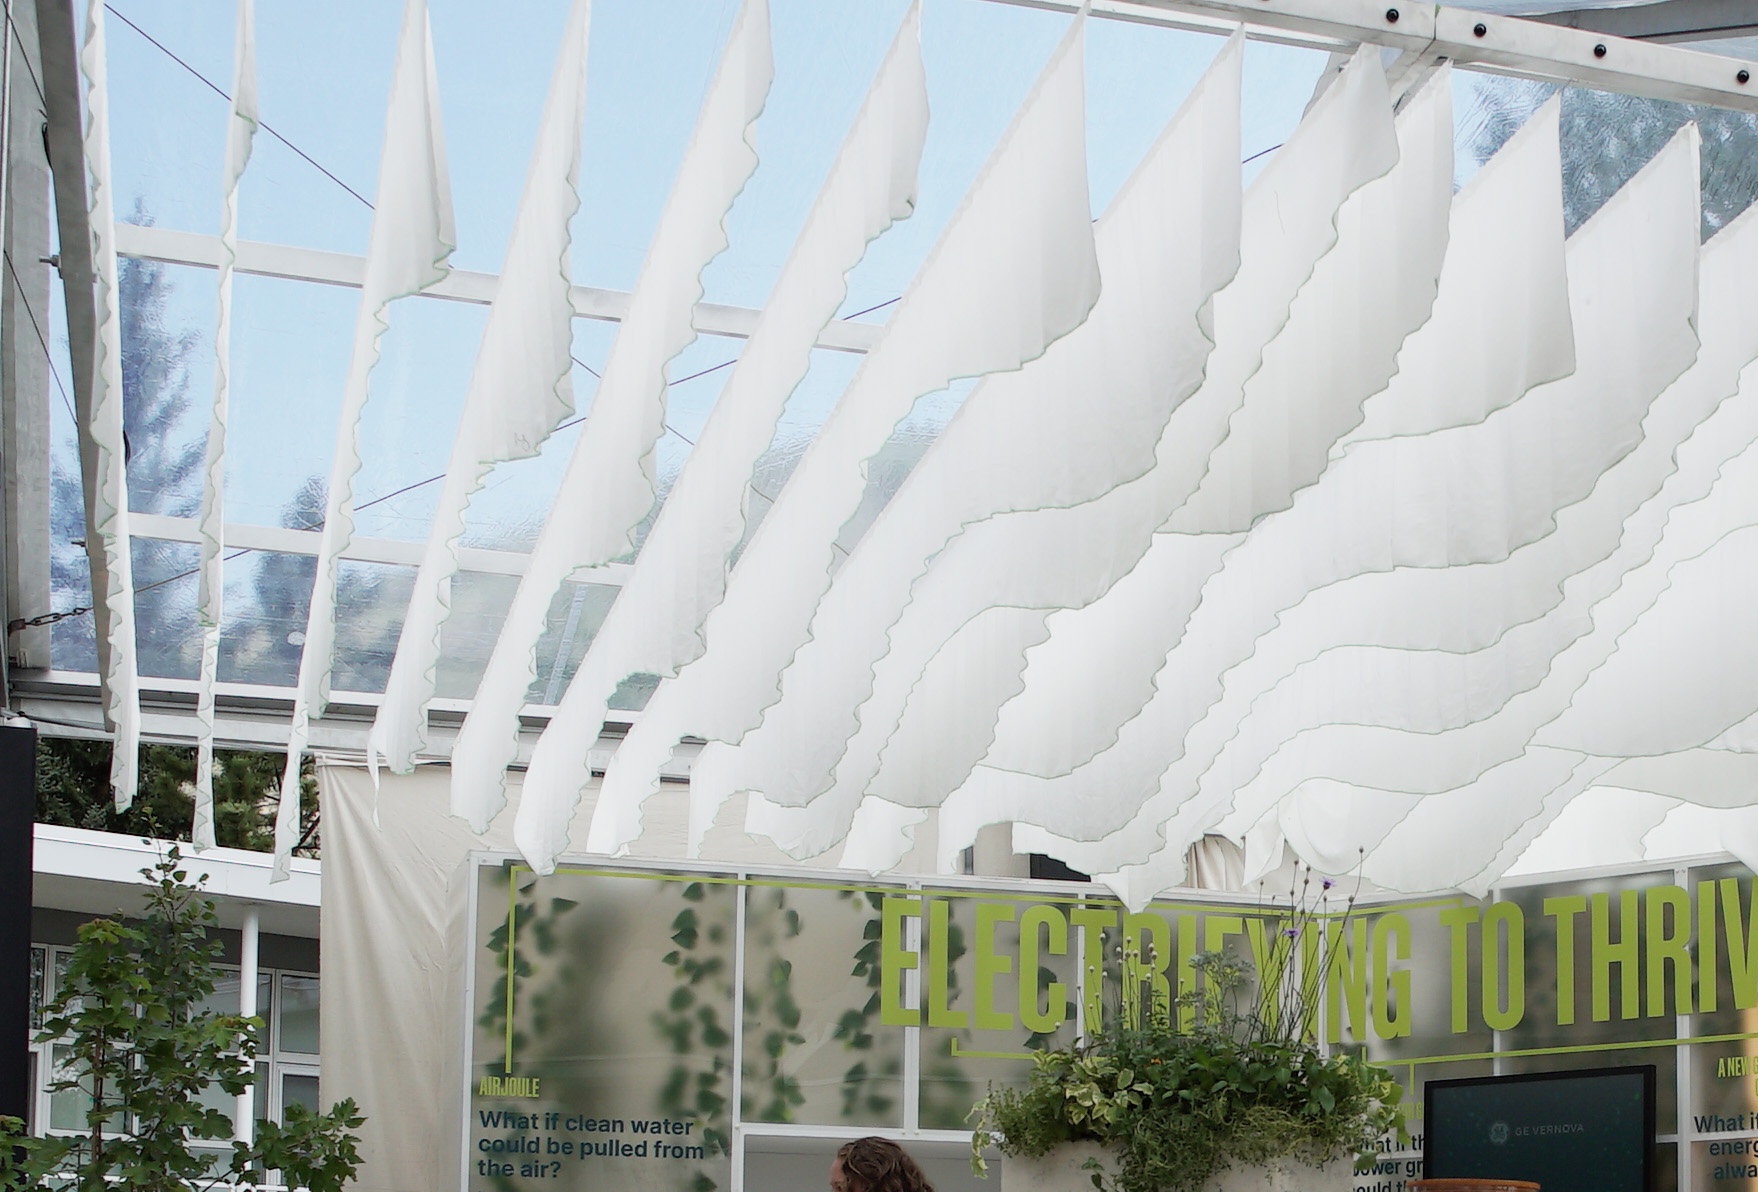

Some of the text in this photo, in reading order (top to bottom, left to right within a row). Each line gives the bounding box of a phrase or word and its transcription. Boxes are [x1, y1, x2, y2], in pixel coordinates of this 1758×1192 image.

[881, 896, 1412, 1045] ELECTRIFYING
[1438, 900, 1526, 1034] TO
[1717, 1057, 1727, 1078] A
[1727, 1056, 1750, 1078] NEW
[478, 1075, 540, 1098] AIRJOULE
[479, 1110, 694, 1136] What if clean water
[1515, 1123, 1584, 1136] GE VERNOVA
[1694, 1113, 1746, 1133] What
[478, 1137, 705, 1160] could be pulled from
[477, 1159, 562, 1178] the air?
